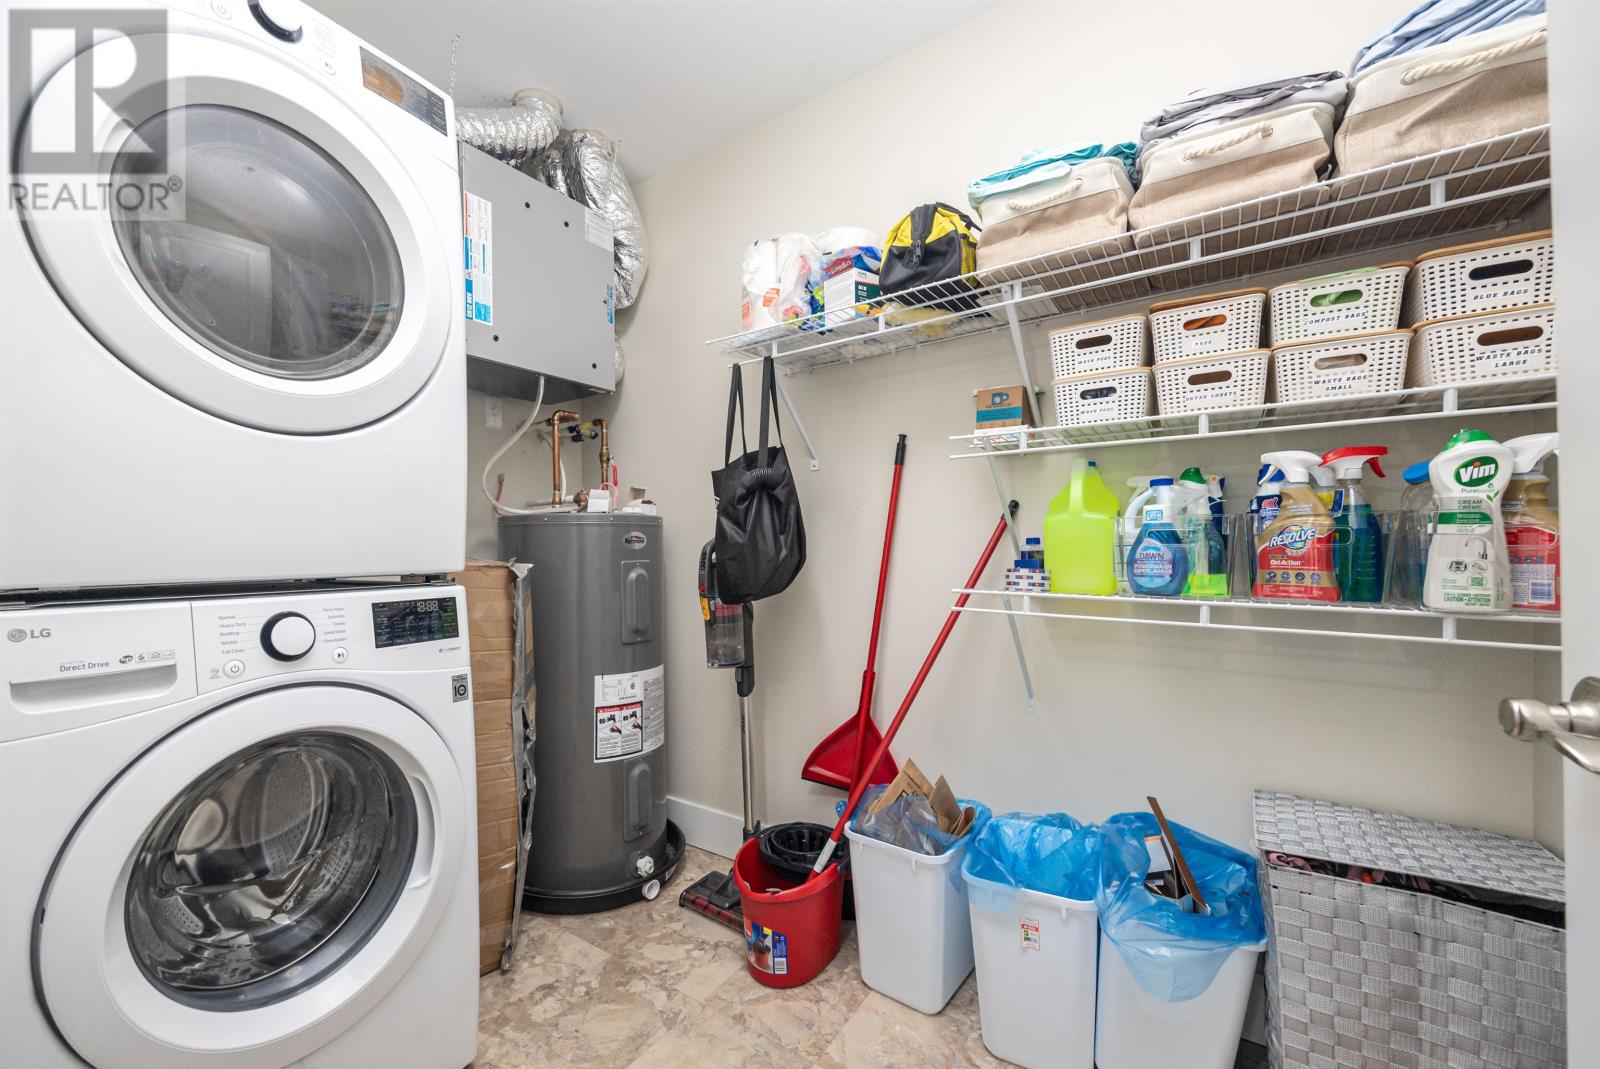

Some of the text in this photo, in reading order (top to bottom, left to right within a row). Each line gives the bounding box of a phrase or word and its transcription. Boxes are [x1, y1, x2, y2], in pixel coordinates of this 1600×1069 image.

[1472, 287, 1530, 301] BLUE BAGS
[1303, 311, 1366, 325] COMPOST BAGS
[1475, 347, 1544, 362] WASTE BAGS
[1494, 359, 1529, 369] LARGE
[1313, 374, 1368, 385] WASTE BAGS
[1325, 384, 1354, 392] SMALL
[1210, 391, 1238, 399] SHEETS
[1459, 461, 1496, 483] Vim
[1139, 552, 1165, 560] DAWN
[30, 628, 51, 639] LG
[60, 663, 86, 672] Direct
[88, 661, 110, 670] Drive
